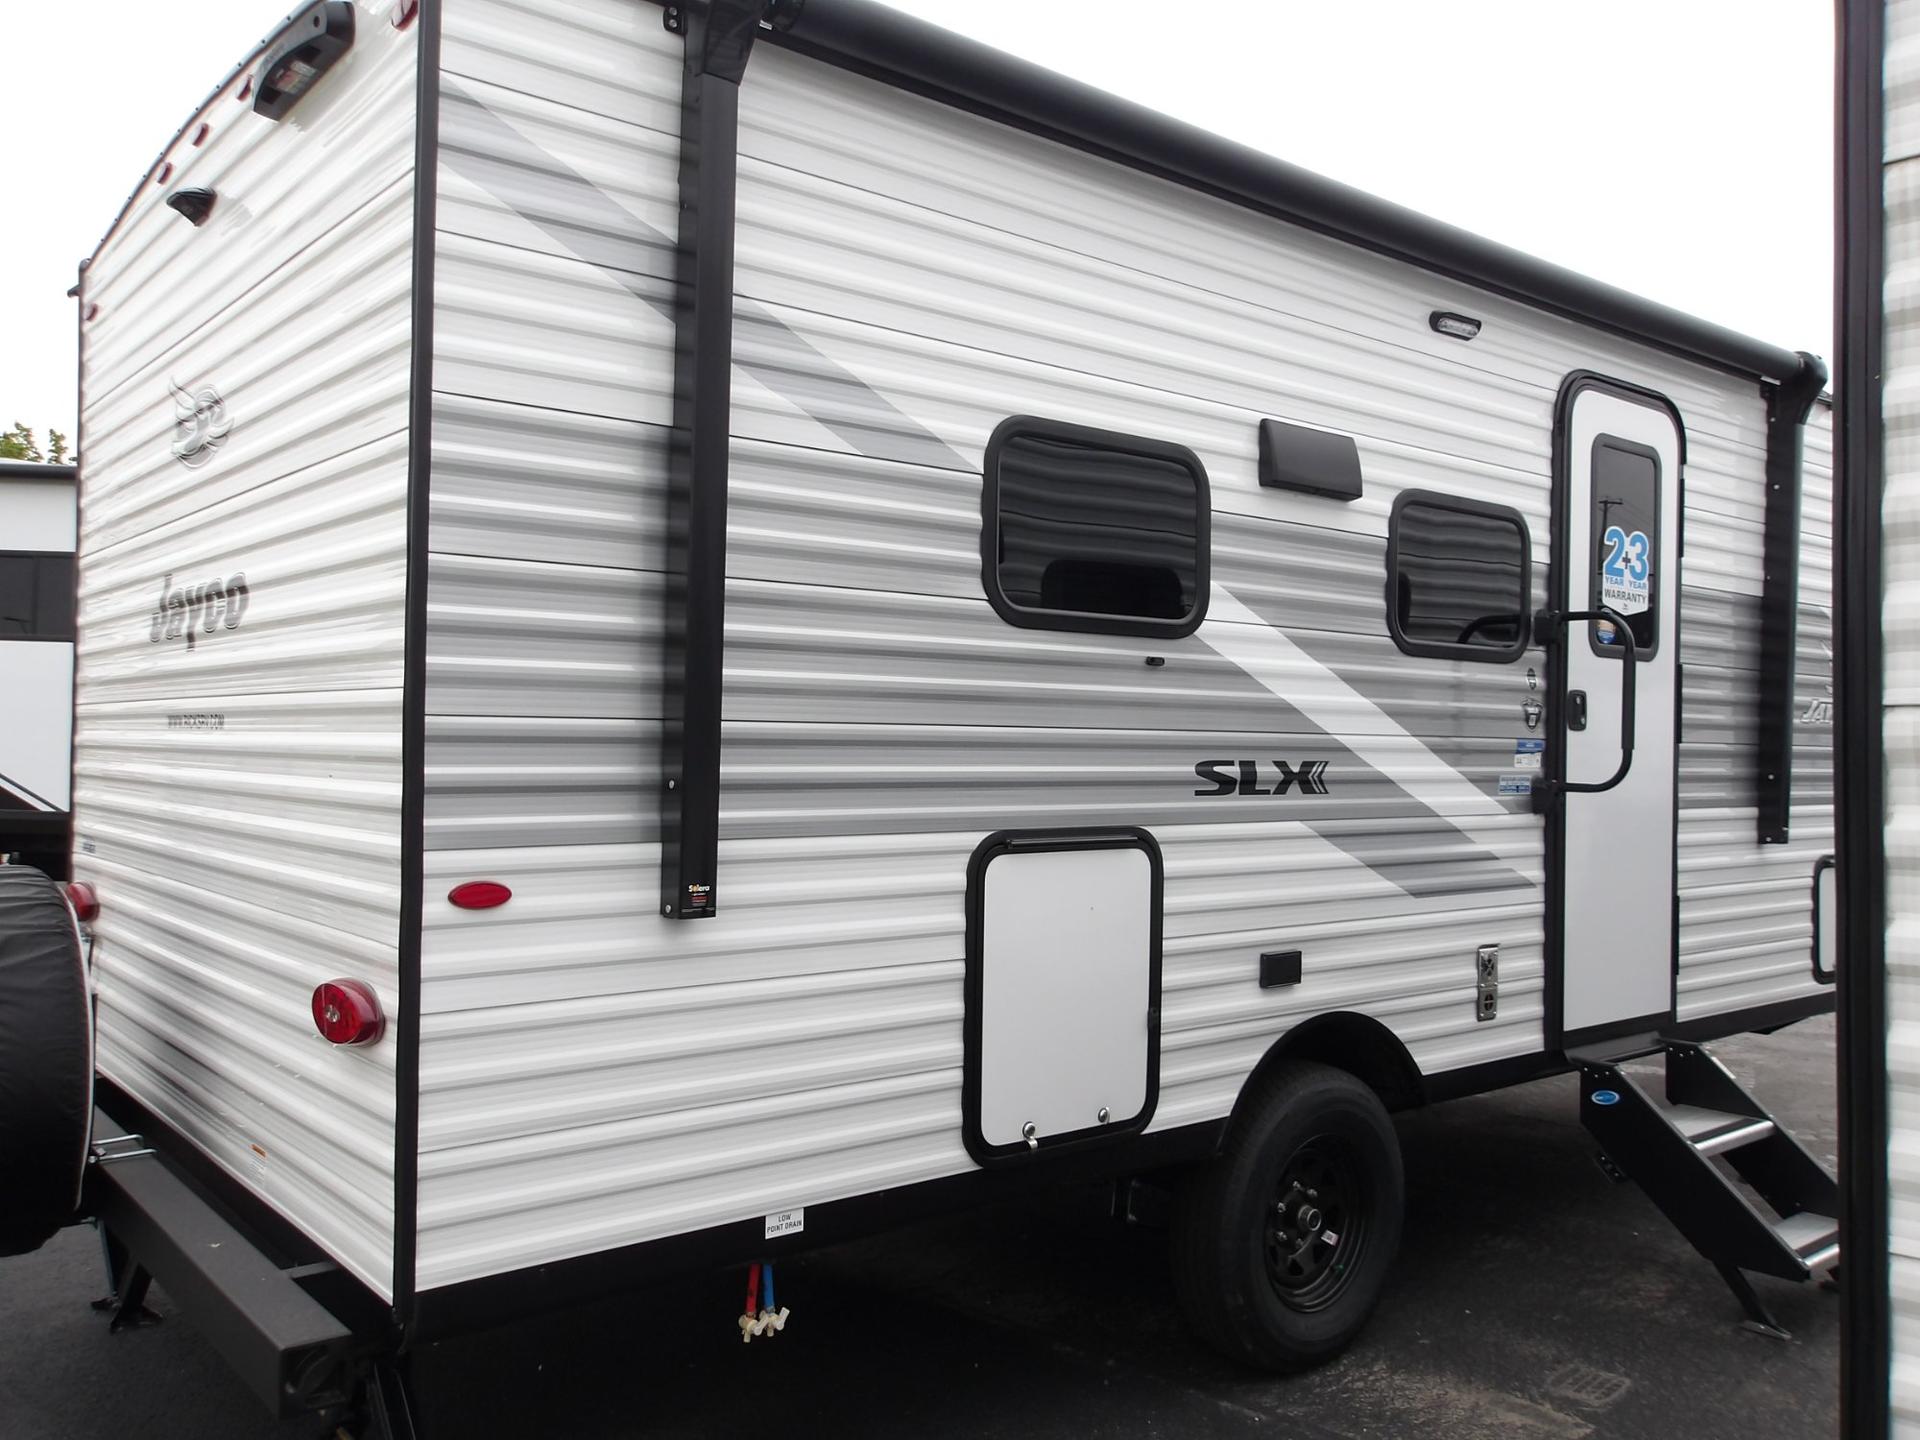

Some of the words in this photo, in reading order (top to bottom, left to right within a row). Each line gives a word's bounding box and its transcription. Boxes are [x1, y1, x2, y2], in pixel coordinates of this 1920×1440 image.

[1604, 575, 1624, 586] YEAR
[1628, 580, 1647, 590] YEAR
[1604, 588, 1647, 603] WARRANTY
[150, 573, 249, 652] Jayco
[1194, 760, 1330, 796] SLX
[778, 1213, 792, 1223] LOW
[767, 1224, 784, 1233] POINT
[785, 1220, 802, 1230] DRAIN
